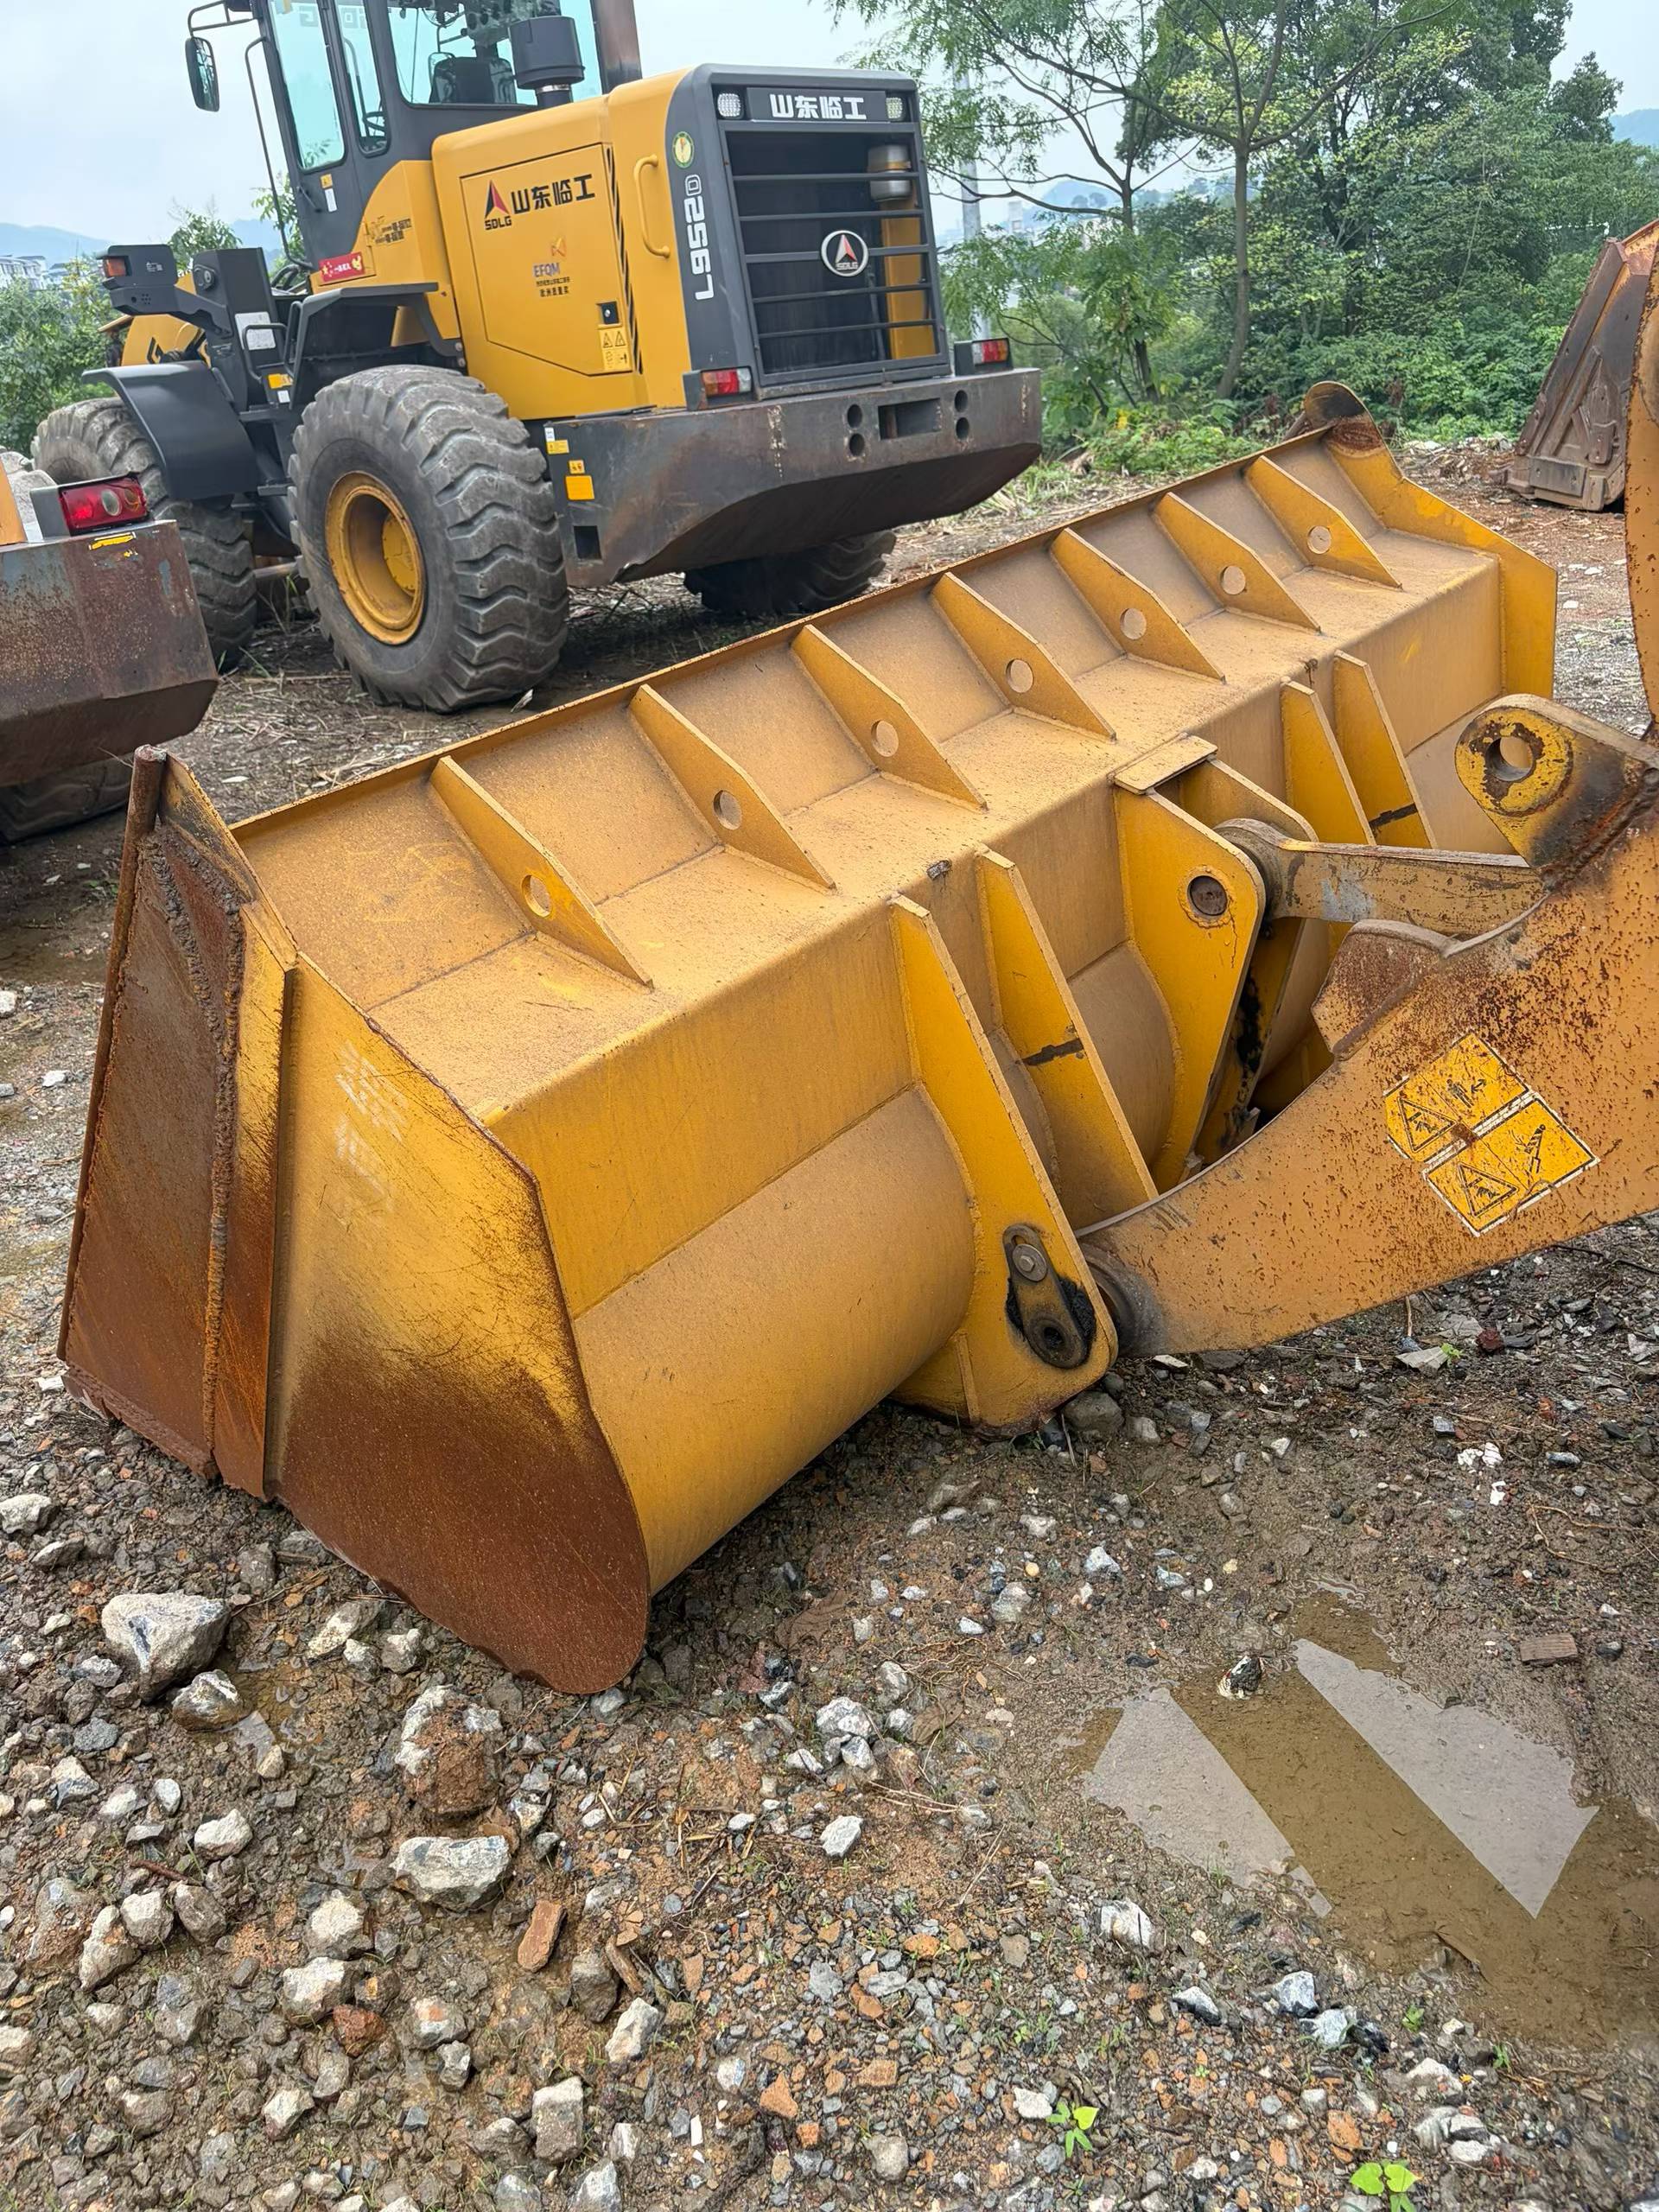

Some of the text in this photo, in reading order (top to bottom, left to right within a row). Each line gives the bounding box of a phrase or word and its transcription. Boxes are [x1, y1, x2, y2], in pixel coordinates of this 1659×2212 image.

[770, 93, 867, 120] 山东临工
[511, 174, 595, 214] 山东临工
[485, 215, 512, 231] SDLG
[533, 263, 561, 277] EFQM
